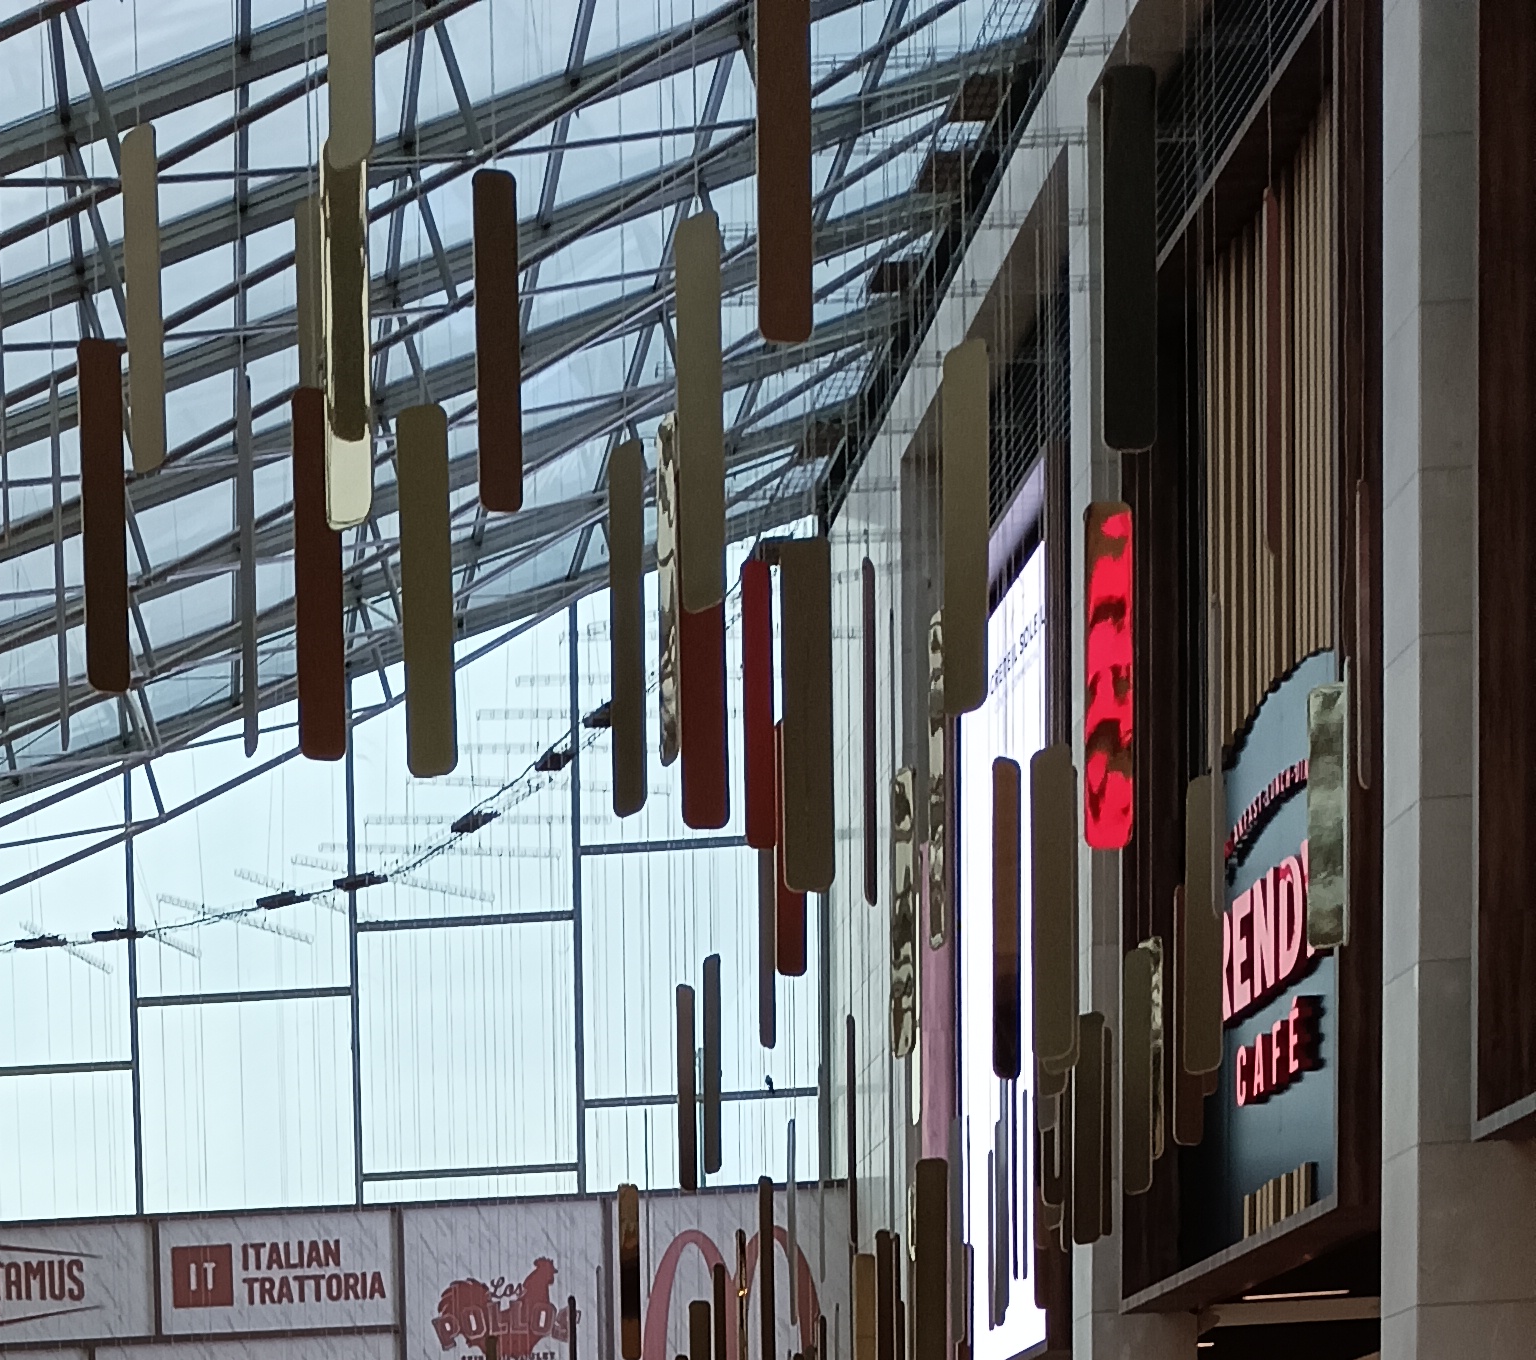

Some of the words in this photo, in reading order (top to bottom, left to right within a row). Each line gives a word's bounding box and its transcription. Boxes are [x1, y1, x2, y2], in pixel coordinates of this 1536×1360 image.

[1223, 839, 1314, 1022] REND
[1236, 996, 1299, 1106] CAFÉ
[241, 1238, 340, 1271] ITALIAN
[189, 1262, 216, 1291] IT
[241, 1271, 386, 1306] TRATTORIA
[490, 1276, 525, 1299] Los
[431, 1300, 582, 1351] POLLOS
